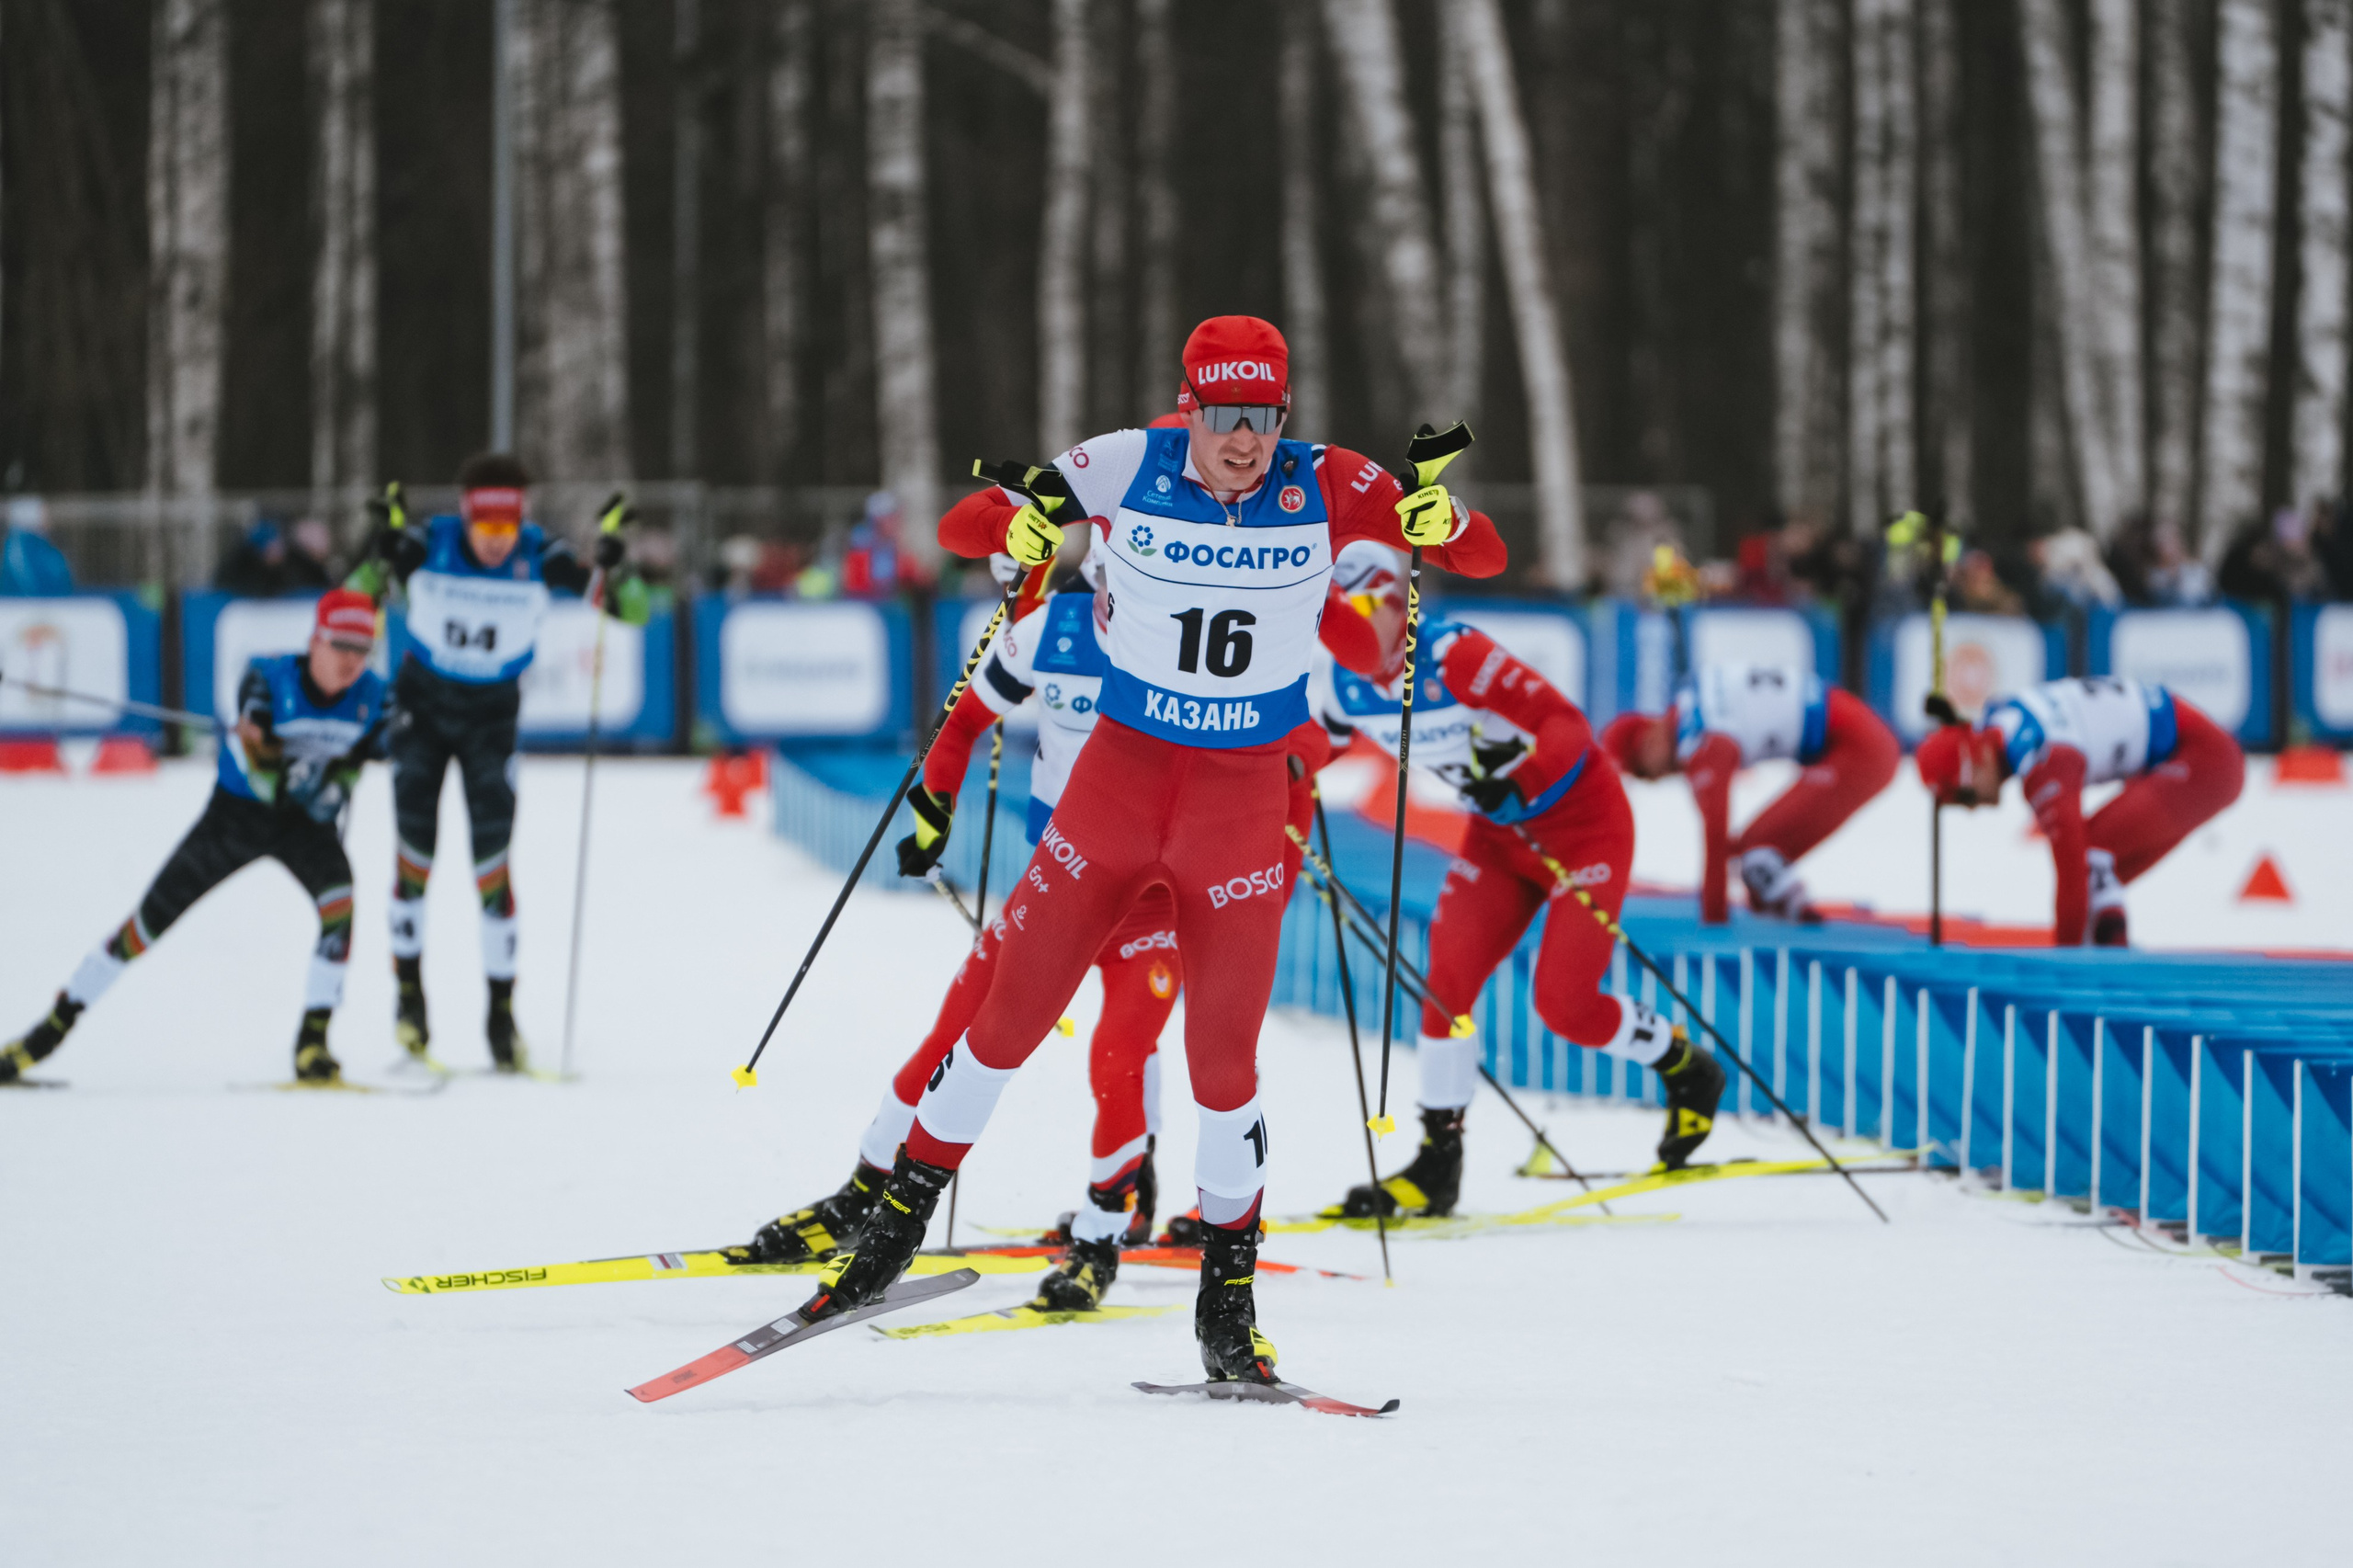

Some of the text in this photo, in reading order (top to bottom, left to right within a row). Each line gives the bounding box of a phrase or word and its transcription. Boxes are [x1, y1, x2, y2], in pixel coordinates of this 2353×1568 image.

[1198, 360, 1276, 385] LUKOIL
[1164, 541, 1311, 570] ФОСАГРО
[1170, 607, 1256, 678] 16
[1144, 689, 1260, 731] КАЗАНЬ
[1042, 817, 1088, 881] UKOIL
[1029, 865, 1049, 892] En+
[1208, 862, 1284, 909] BOSCO
[1244, 1111, 1267, 1168] 1
[436, 1267, 547, 1290] FISCHER
